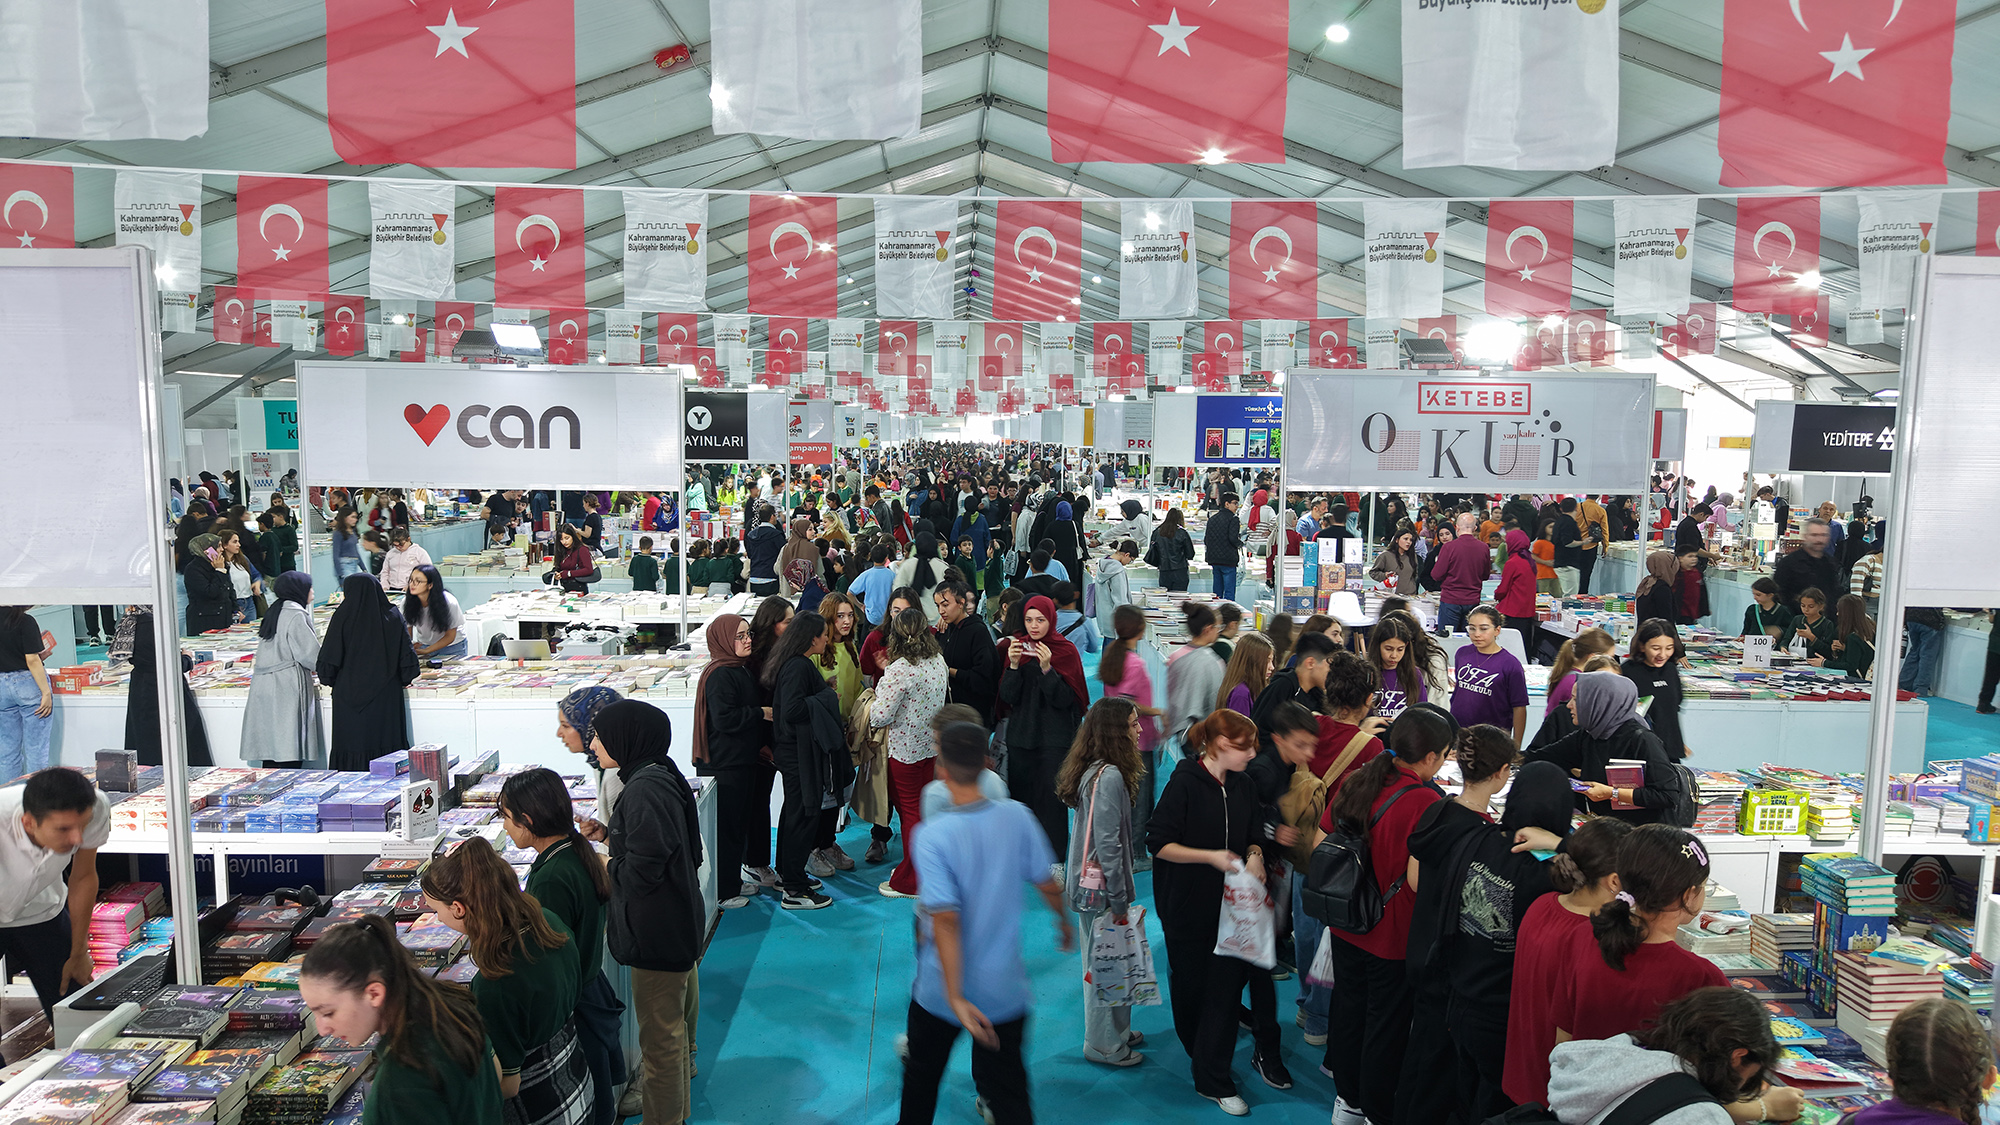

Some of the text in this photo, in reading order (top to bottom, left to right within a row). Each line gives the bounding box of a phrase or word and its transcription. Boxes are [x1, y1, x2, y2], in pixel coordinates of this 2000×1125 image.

[120, 214, 179, 224] Kahramanmaraş
[121, 224, 154, 234] Büyükşehir
[376, 224, 433, 234] Kahramanmaraş
[376, 233, 432, 243] Büyükşehir Belediyesi
[628, 234, 686, 244] Kahramanmaraş
[1862, 234, 1919, 244] Kahramanmaraş
[628, 244, 686, 253] Büyükşehir Belediyesi
[879, 241, 936, 251] Kahramanmaraş
[1133, 244, 1181, 253] hramanmaraş
[1368, 243, 1424, 253] Kahramanmaraş
[1619, 239, 1675, 249] Kahramanmaraş
[879, 251, 935, 261] Büyükşehir Belediyesi
[1124, 253, 1181, 264] Büyükşehir Belediyesi
[1369, 253, 1424, 262] Büyükşehir Belediyesi
[1619, 250, 1649, 260] Büyükşehir
[1426, 390, 1523, 407] KETEBE
[278, 411, 297, 424] TU
[692, 412, 707, 425] Y
[457, 404, 581, 449] can
[1519, 430, 1536, 438] kalır
[1822, 430, 1874, 447] YEDİTEPE
[685, 435, 744, 447] AYINLARI
[1458, 663, 1499, 688] ÖFA
[229, 854, 299, 877] ayınları
